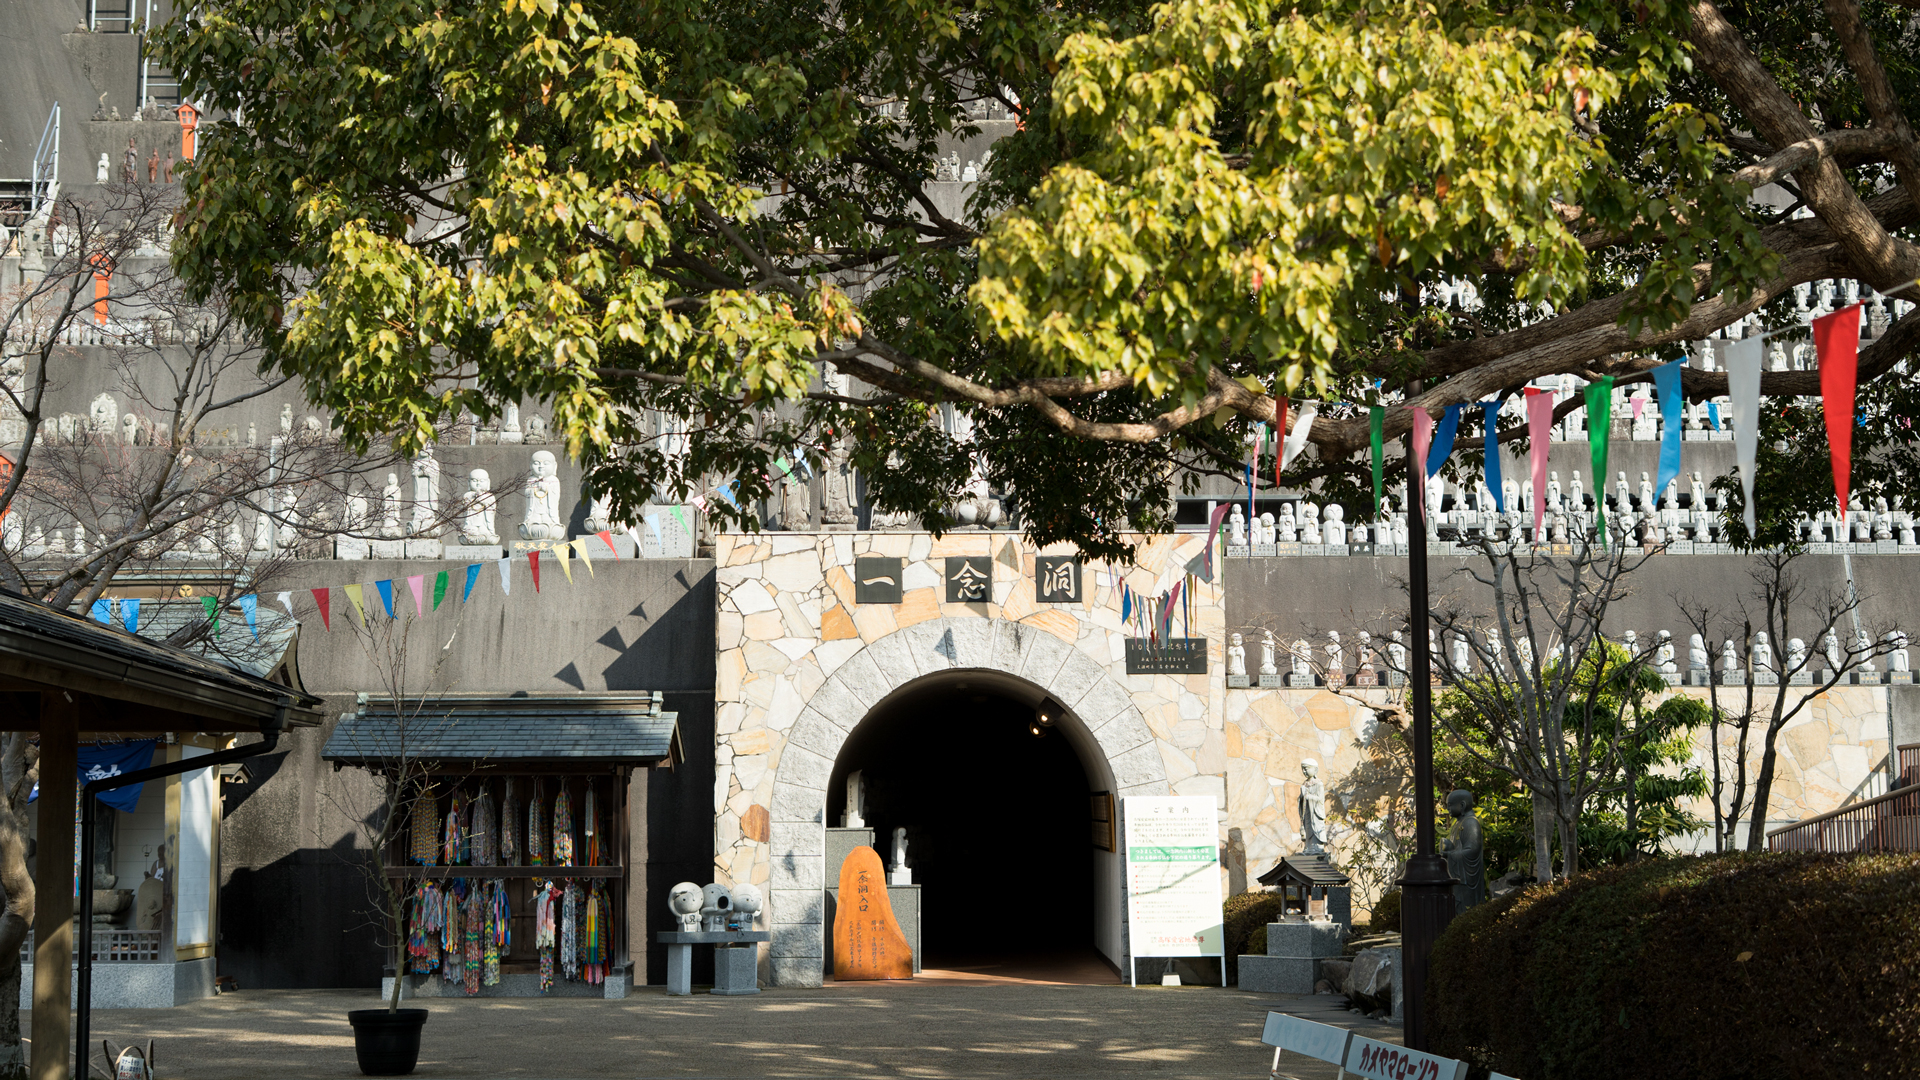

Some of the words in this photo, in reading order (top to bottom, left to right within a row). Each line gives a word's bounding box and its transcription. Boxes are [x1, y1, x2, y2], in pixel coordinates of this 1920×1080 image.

[862, 560, 1076, 600] 一念洞
[1153, 806, 1190, 814] ご案内
[858, 870, 869, 912] 一念洞入口
[1359, 1043, 1440, 1080] カメヤマローソク
